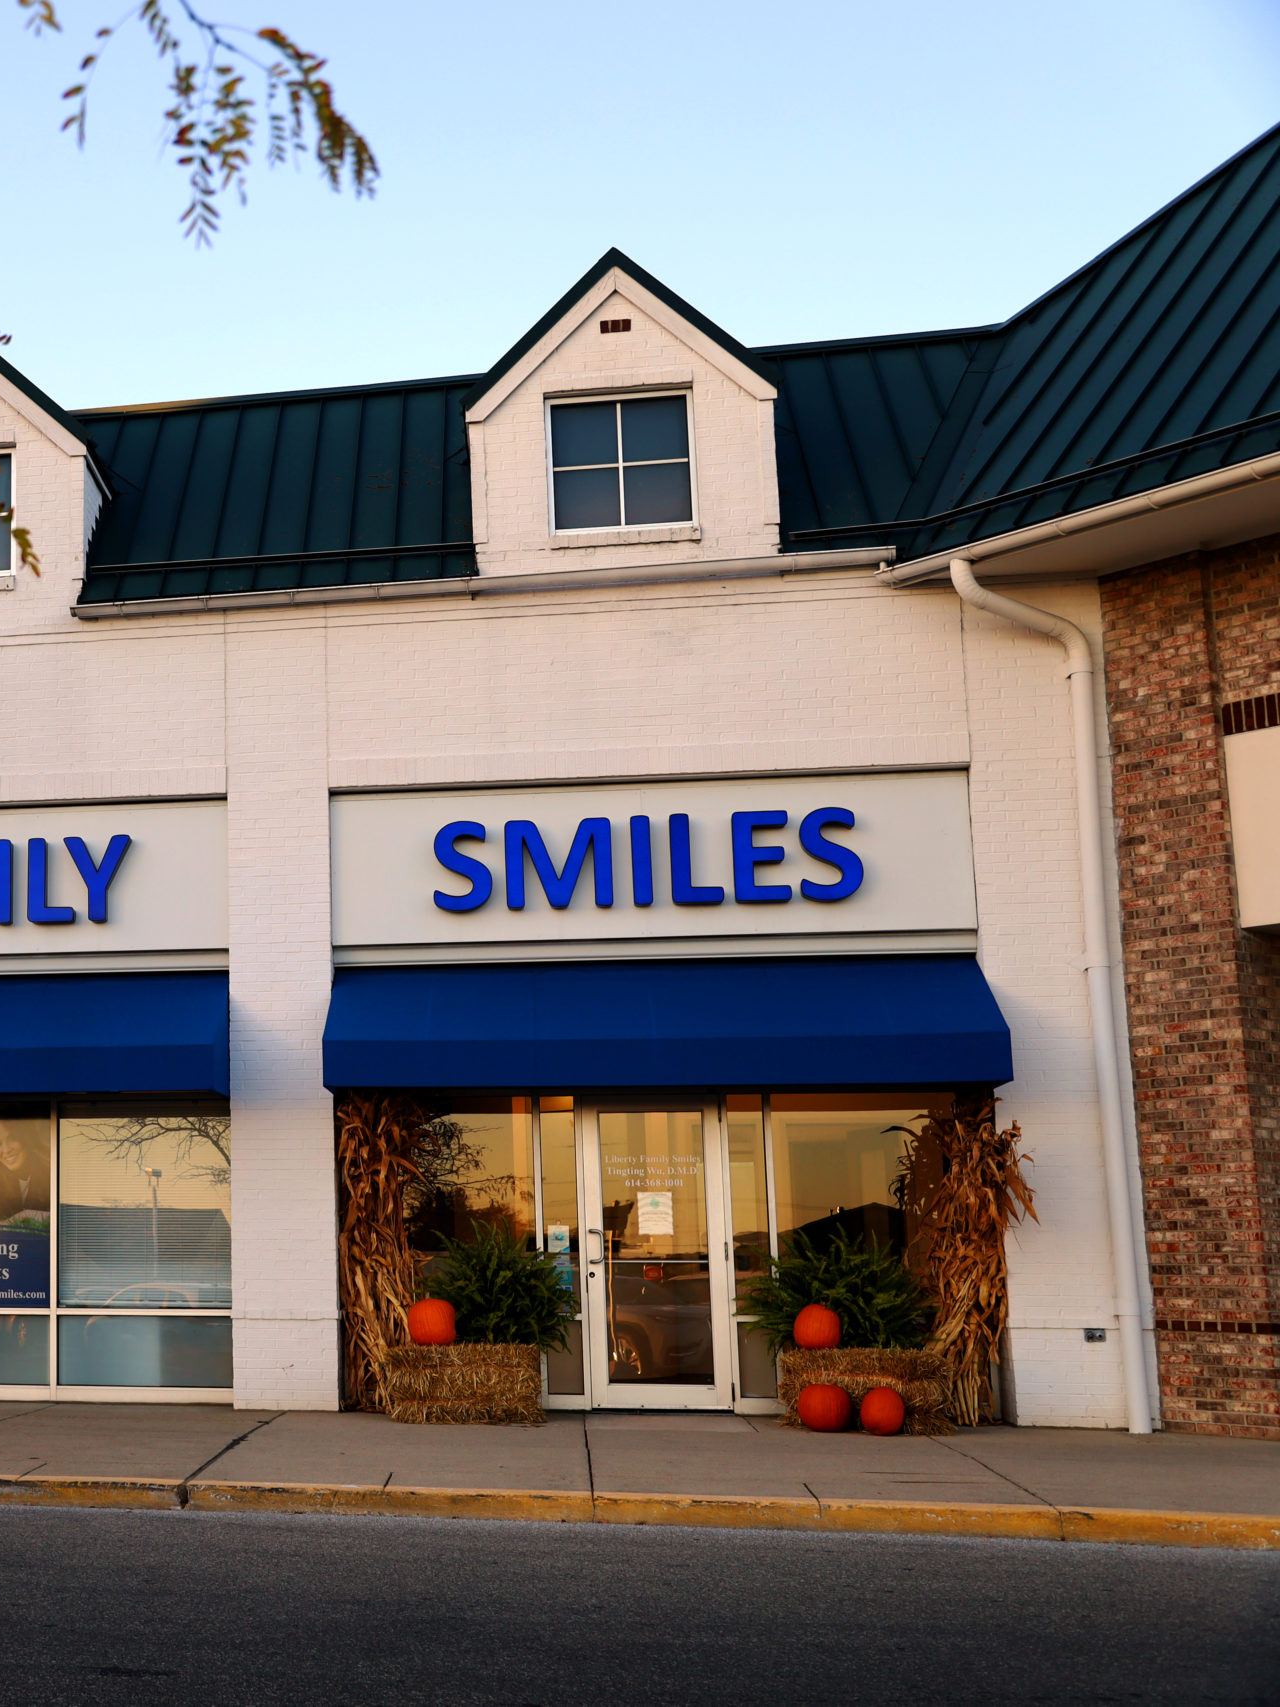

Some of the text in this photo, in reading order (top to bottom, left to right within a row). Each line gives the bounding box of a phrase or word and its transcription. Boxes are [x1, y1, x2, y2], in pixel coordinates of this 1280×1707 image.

[433, 806, 864, 914] SMILES
[605, 1154, 700, 1165] Liberty Family Smiles
[607, 1167, 645, 1177] Tingting
[625, 1179, 684, 1187] 614-368-1001
